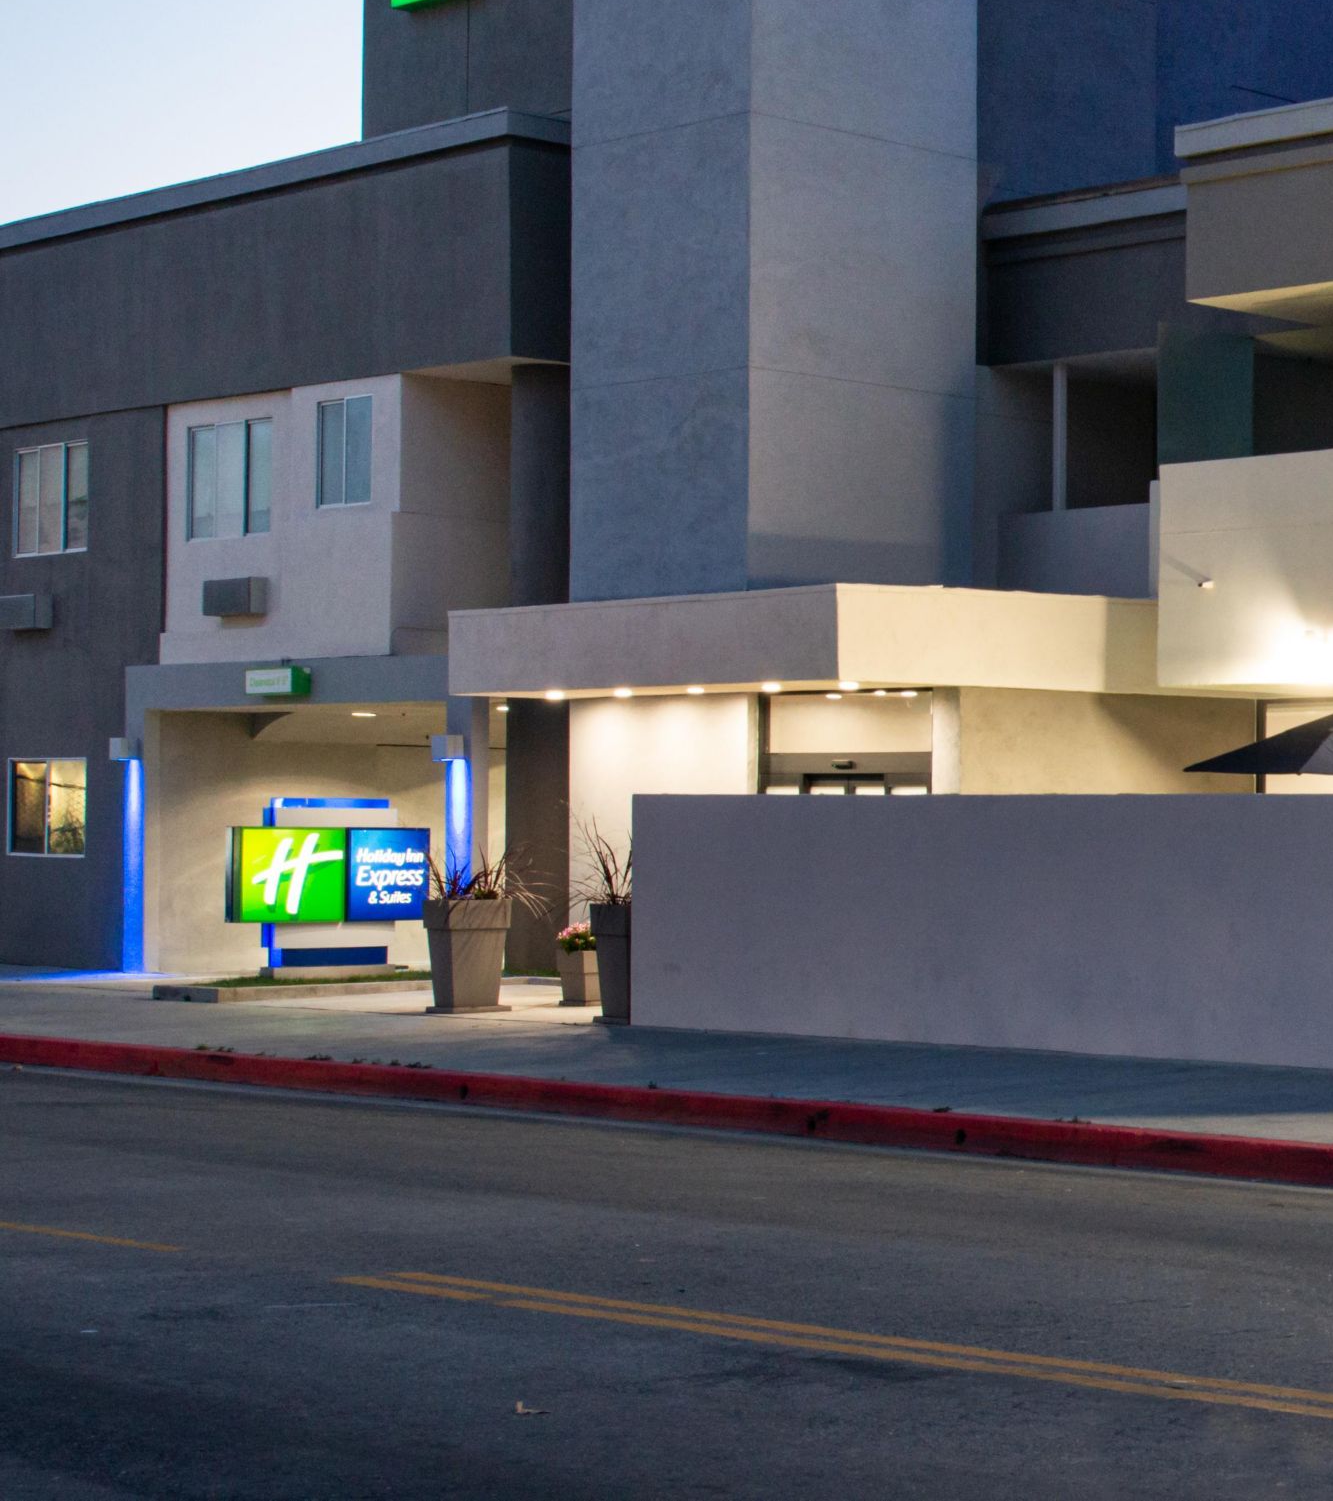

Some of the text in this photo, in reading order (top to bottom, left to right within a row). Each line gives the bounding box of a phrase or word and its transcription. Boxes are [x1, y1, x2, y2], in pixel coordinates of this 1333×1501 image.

[355, 847, 424, 867] Holiday Inn
[355, 865, 425, 891] Express
[368, 890, 412, 904] & Suites
